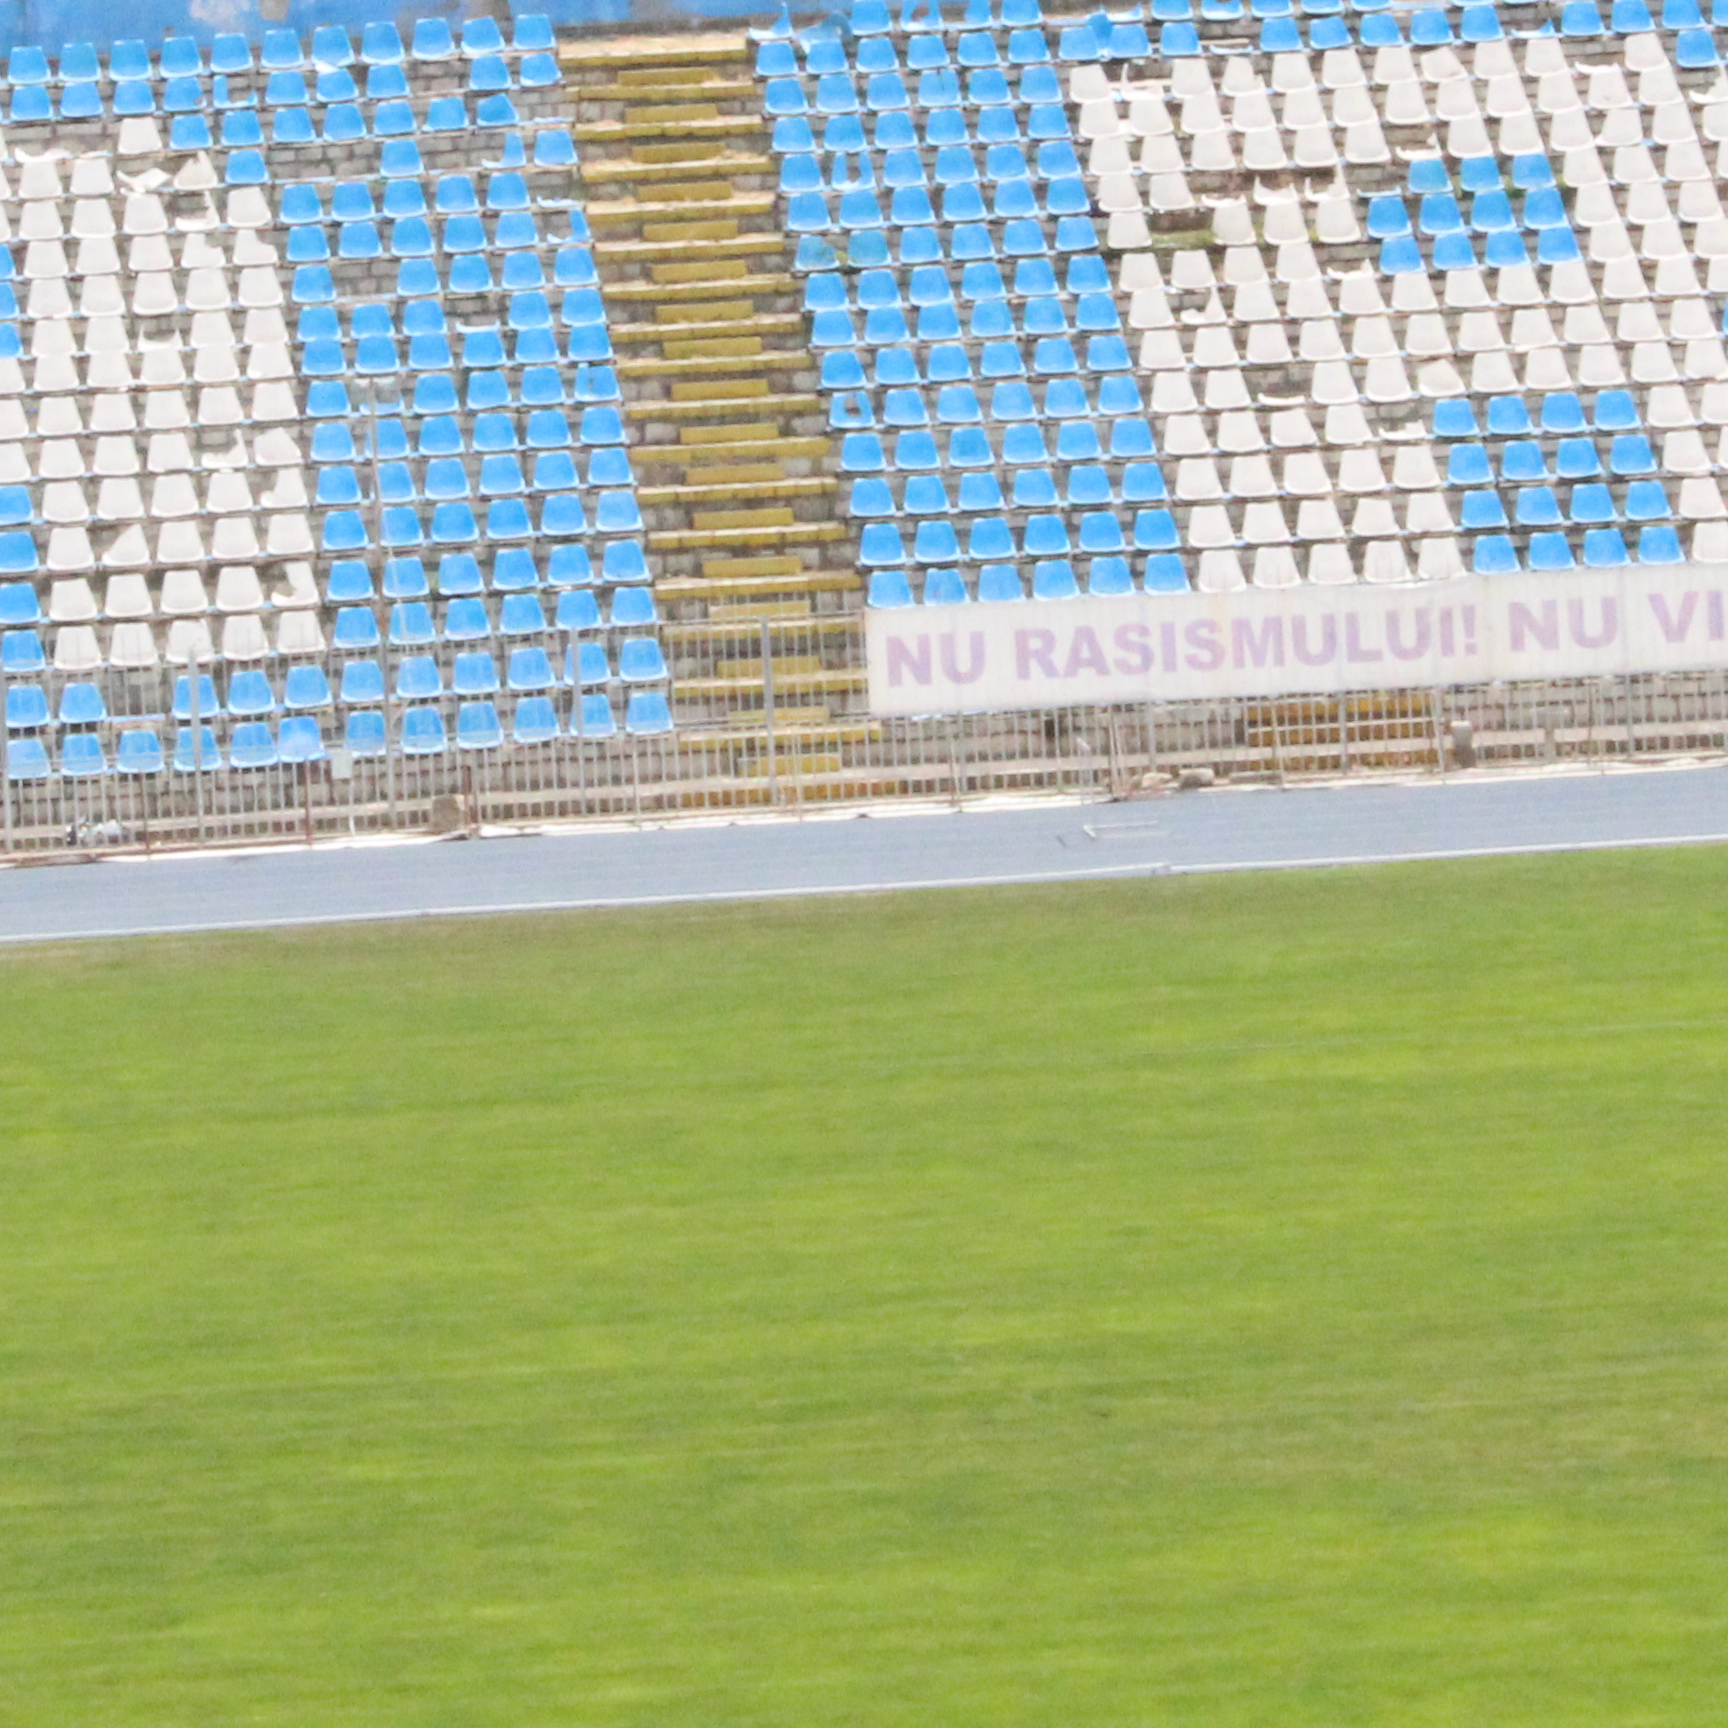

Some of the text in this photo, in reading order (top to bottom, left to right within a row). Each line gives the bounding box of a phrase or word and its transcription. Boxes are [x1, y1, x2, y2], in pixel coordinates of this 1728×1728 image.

[884, 629, 988, 688] NU
[1012, 603, 1479, 681] RASISMULUI!
[1506, 595, 1619, 653] NU
